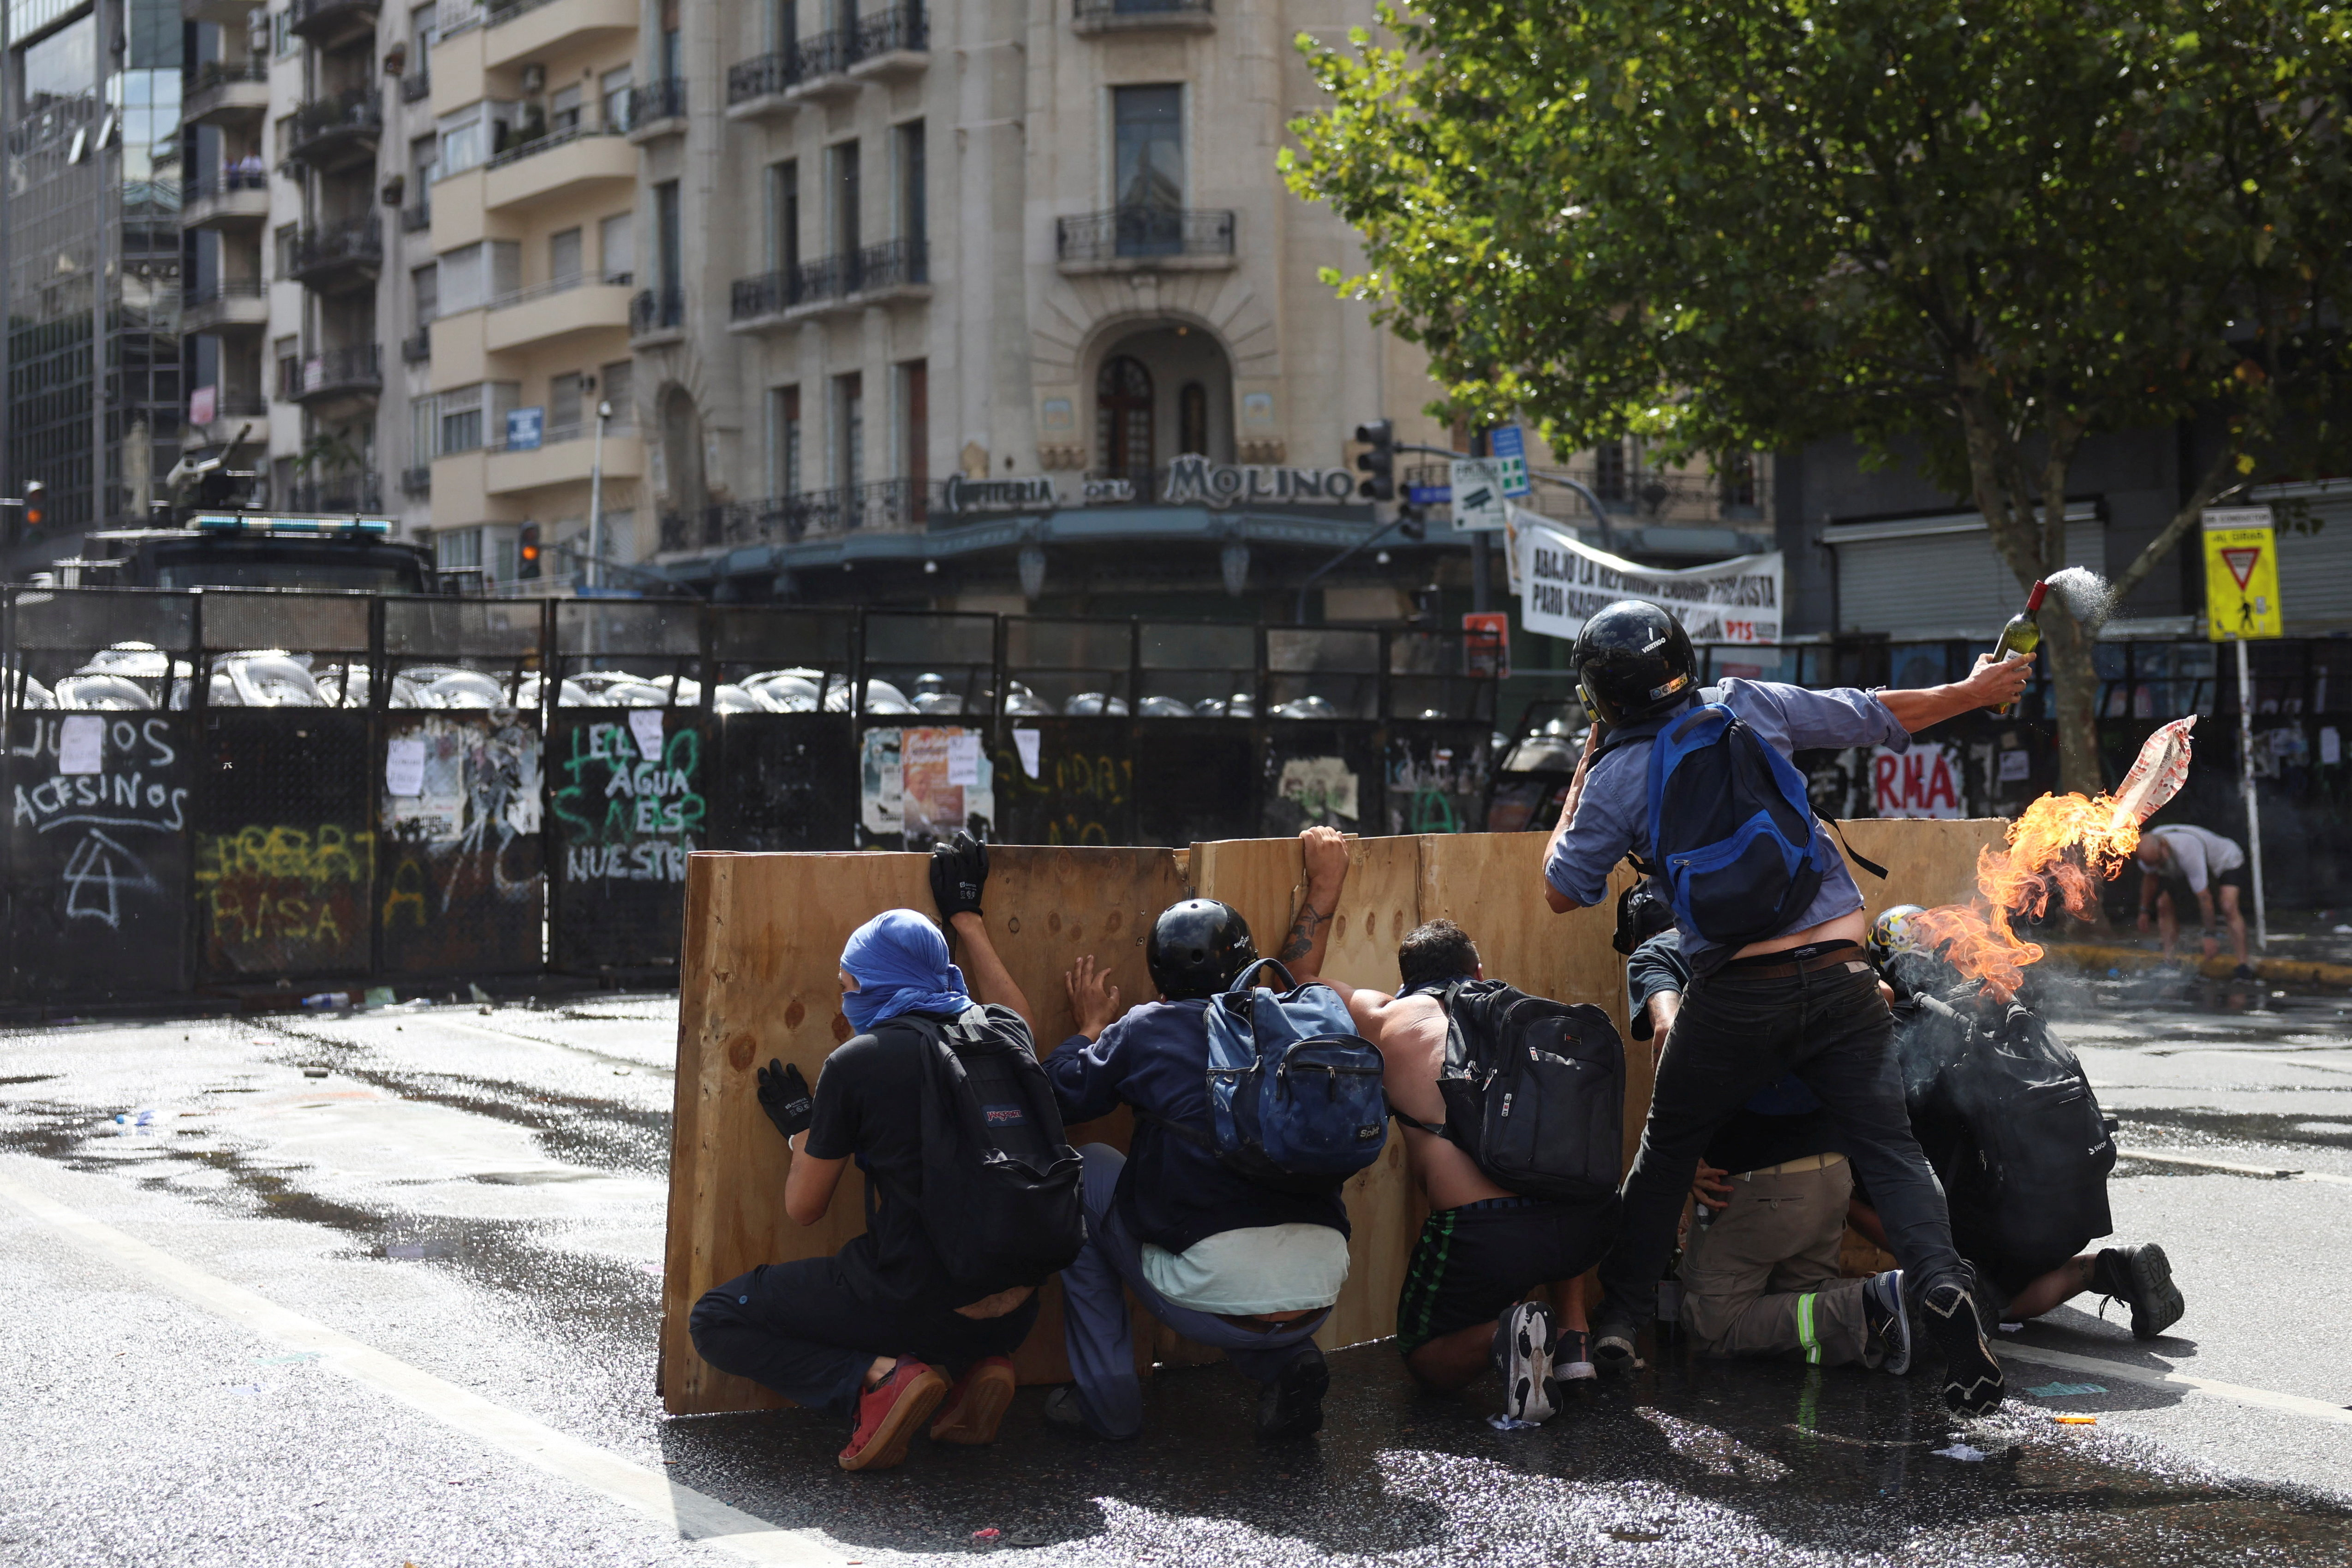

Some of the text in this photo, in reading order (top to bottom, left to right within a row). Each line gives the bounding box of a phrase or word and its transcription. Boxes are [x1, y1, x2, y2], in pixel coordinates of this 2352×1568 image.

[1164, 453, 1355, 507] MOLINO
[1533, 548, 1575, 582] ABAJO
[1580, 556, 1594, 585] LA
[1642, 637, 1666, 654] VERTIGO
[1725, 620, 1752, 640] PTS
[605, 764, 690, 798] AGUA
[637, 800, 685, 832] ES
[1360, 1126, 1379, 1139] Spirit
